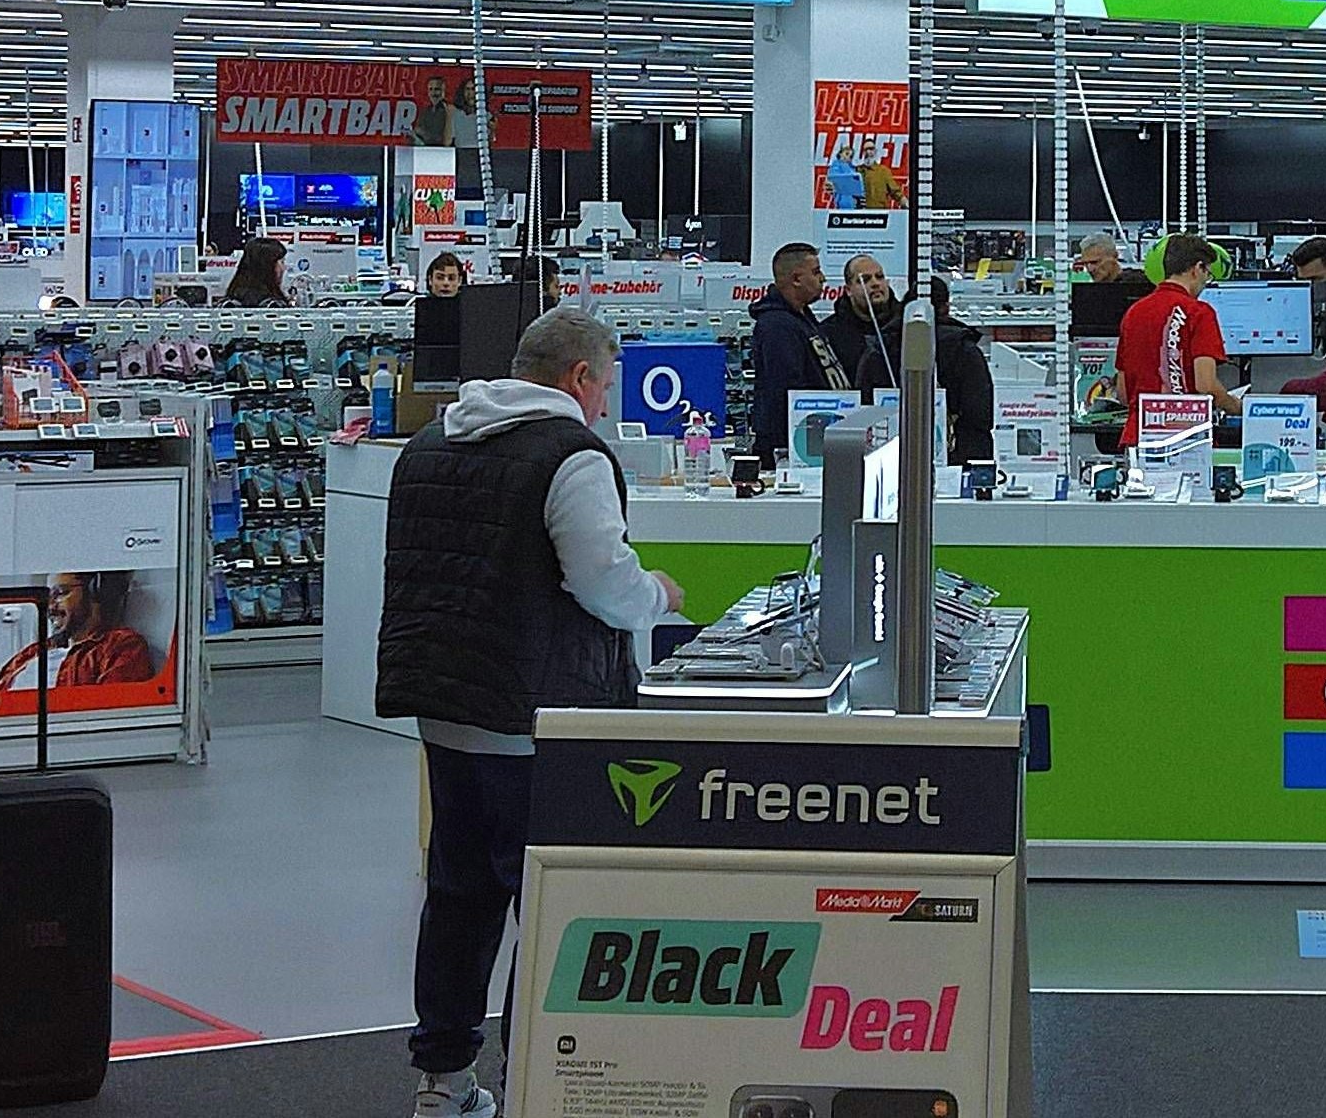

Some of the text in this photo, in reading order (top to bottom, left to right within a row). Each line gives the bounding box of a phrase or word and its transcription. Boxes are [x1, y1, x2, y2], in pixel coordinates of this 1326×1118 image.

[221, 95, 418, 136] SMARTBAR
[814, 82, 911, 127] LÄUFT
[814, 125, 911, 169] LÄUFT
[415, 188, 455, 202] CLER
[697, 768, 942, 826] freenet
[933, 904, 974, 919] SATURN
[576, 929, 795, 1006] Black
[799, 985, 961, 1053] Deal
